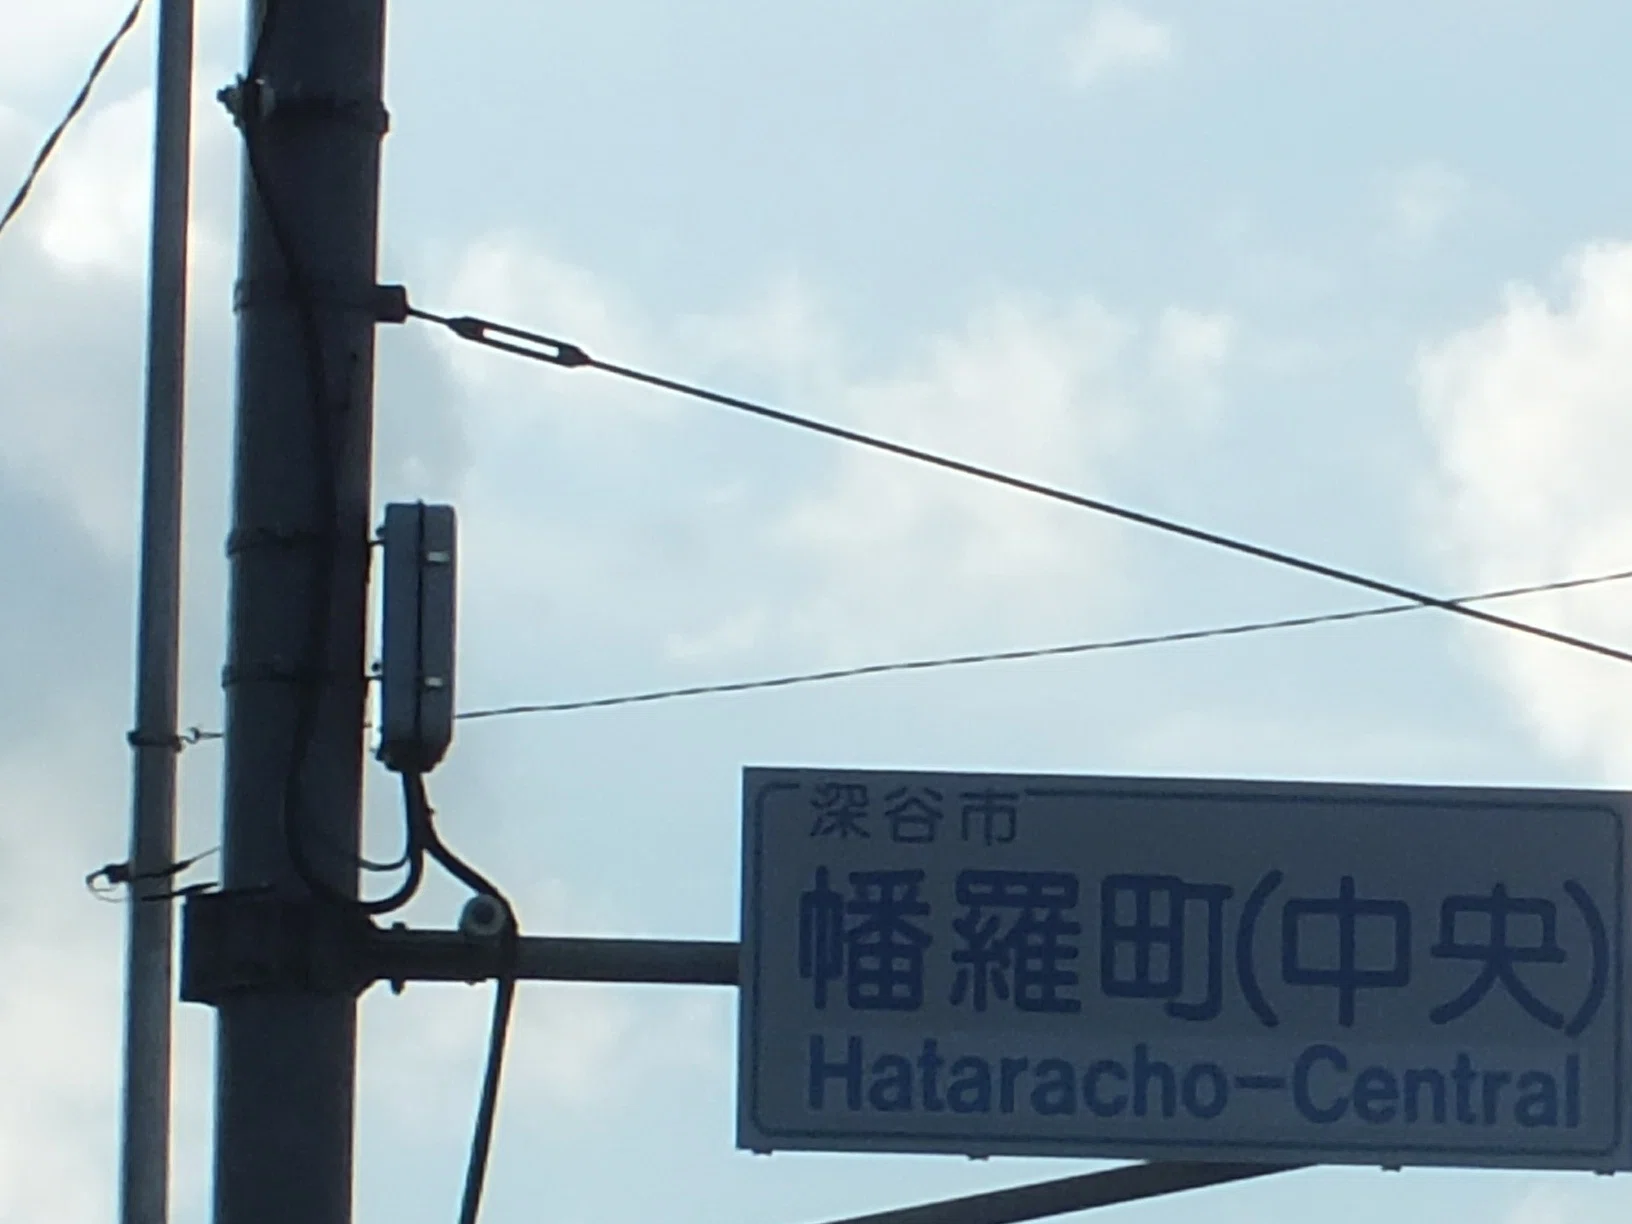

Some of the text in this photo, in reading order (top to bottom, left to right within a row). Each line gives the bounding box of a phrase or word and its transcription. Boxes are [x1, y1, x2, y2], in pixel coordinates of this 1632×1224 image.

[808, 784, 1020, 846] 深谷市
[799, 866, 1609, 1036] 幡羅町(中央)
[809, 1036, 1579, 1127] Hataracho-Central
